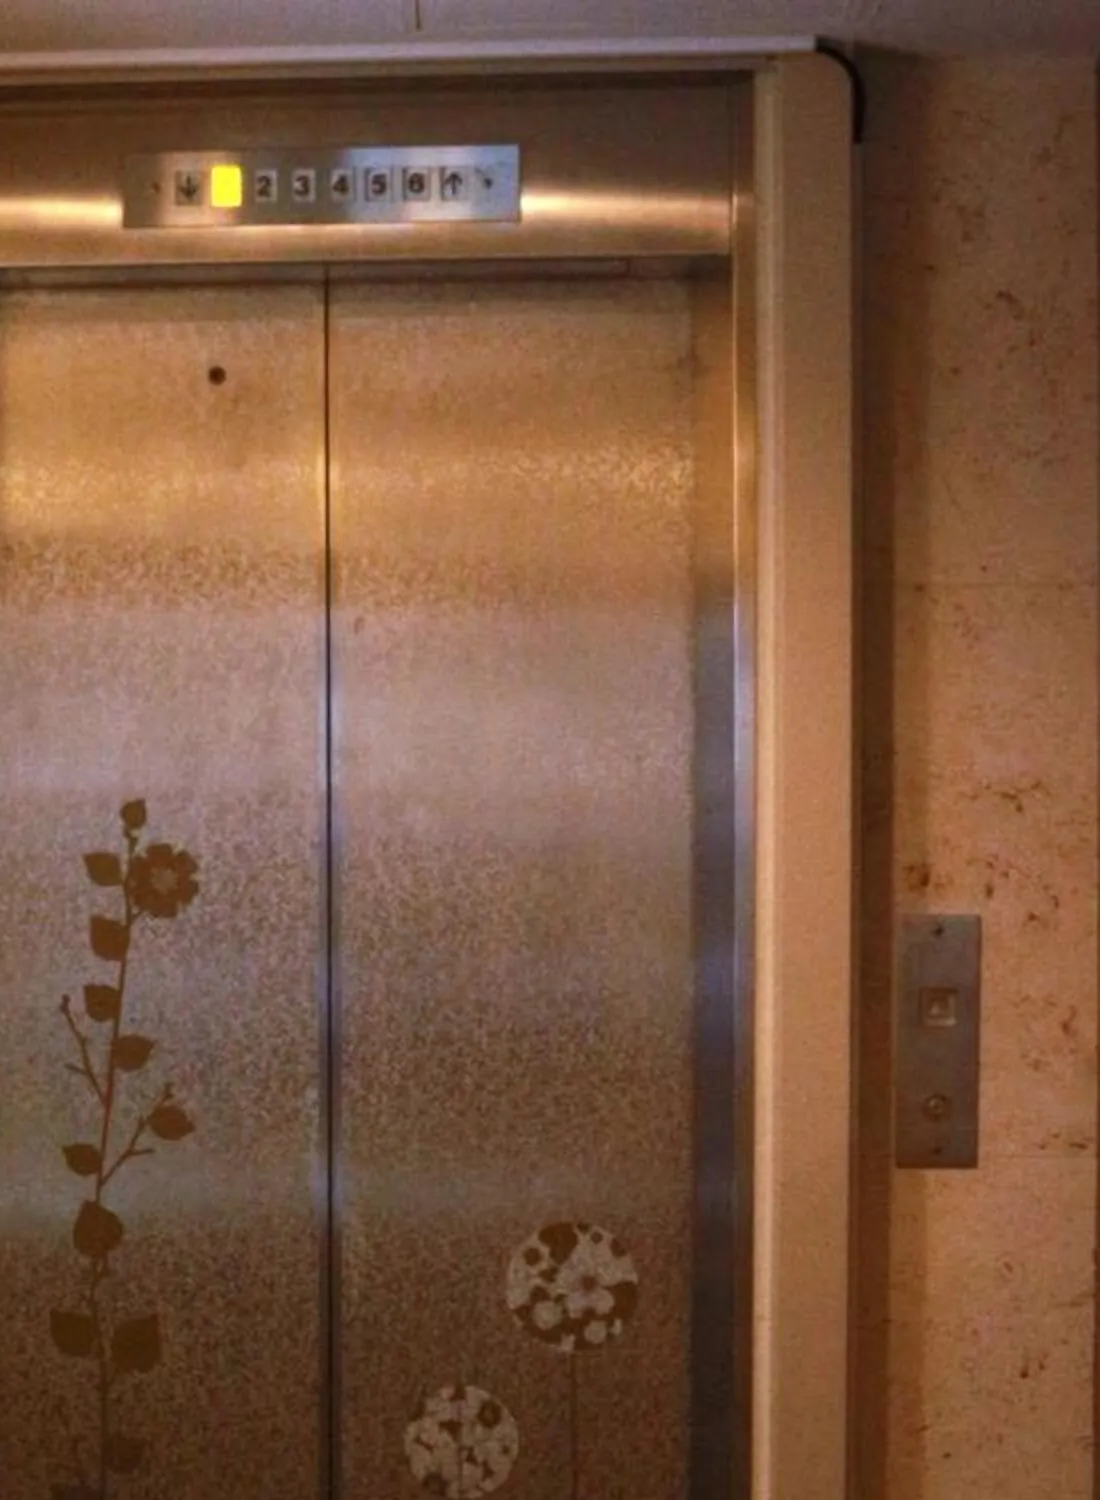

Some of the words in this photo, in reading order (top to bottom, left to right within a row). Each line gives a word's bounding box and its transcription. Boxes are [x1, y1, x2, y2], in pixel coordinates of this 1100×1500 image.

[255, 176, 273, 197] 2
[294, 175, 311, 197] 3
[331, 176, 350, 196] 4
[370, 174, 389, 196] 5
[408, 173, 426, 194] 6
